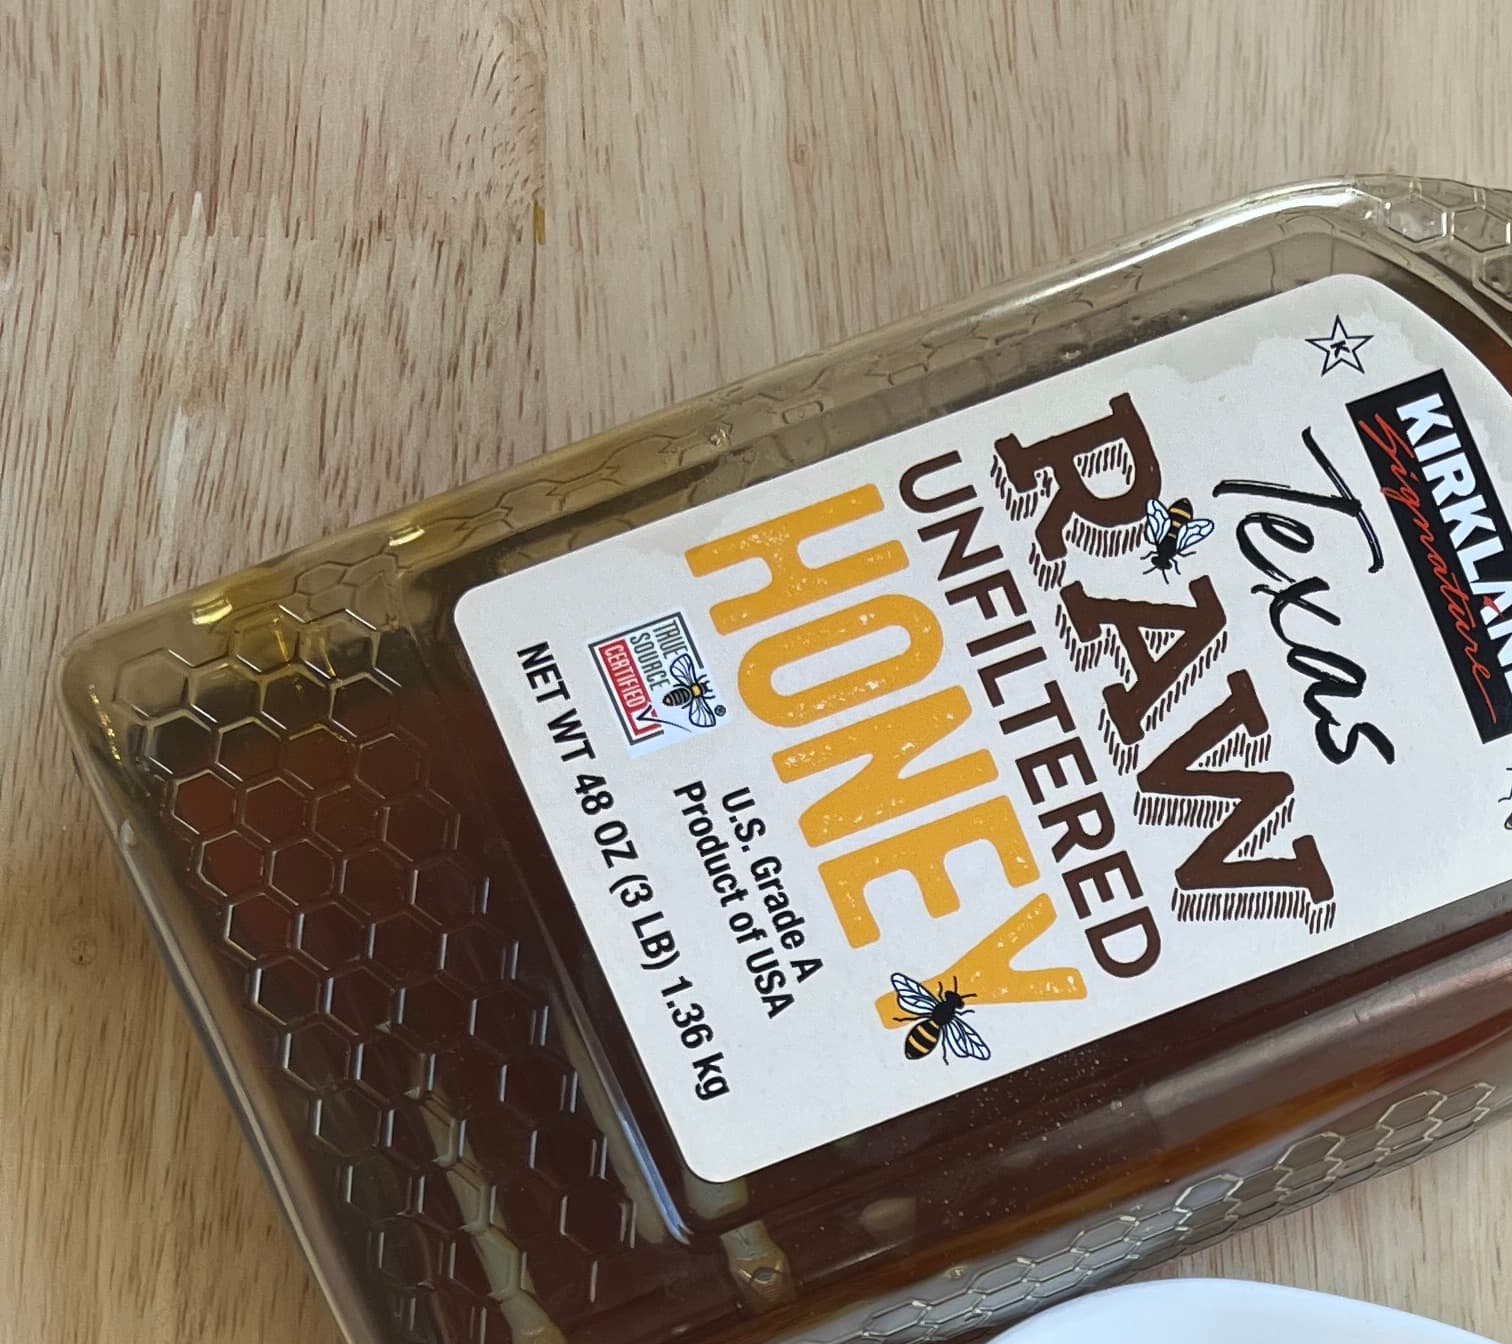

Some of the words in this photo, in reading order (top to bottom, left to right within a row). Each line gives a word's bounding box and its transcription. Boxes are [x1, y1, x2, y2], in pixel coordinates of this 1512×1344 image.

[1330, 340, 1350, 359] K
[1213, 426, 1396, 764] Texas
[1359, 413, 1497, 724] Signature
[629, 632, 671, 691] SOURCE
[652, 619, 689, 659] TRUE
[990, 392, 1336, 934] RAW
[517, 641, 570, 705] NET
[604, 644, 646, 708] CERTIFIED
[547, 708, 596, 762] WT
[899, 450, 1162, 979] UNFILTERED
[684, 483, 1088, 1031] HONEY
[575, 772, 614, 816] 48
[594, 820, 640, 870] OZ
[673, 781, 748, 907] Product
[609, 873, 654, 908] (3
[722, 787, 766, 852] U.S.
[750, 855, 810, 950] Grade
[790, 957, 824, 984] A
[632, 911, 681, 970] LB)
[728, 908, 767, 944] of
[661, 976, 713, 1049] 1.36
[746, 948, 795, 1019] USA
[693, 1052, 730, 1101] kg
